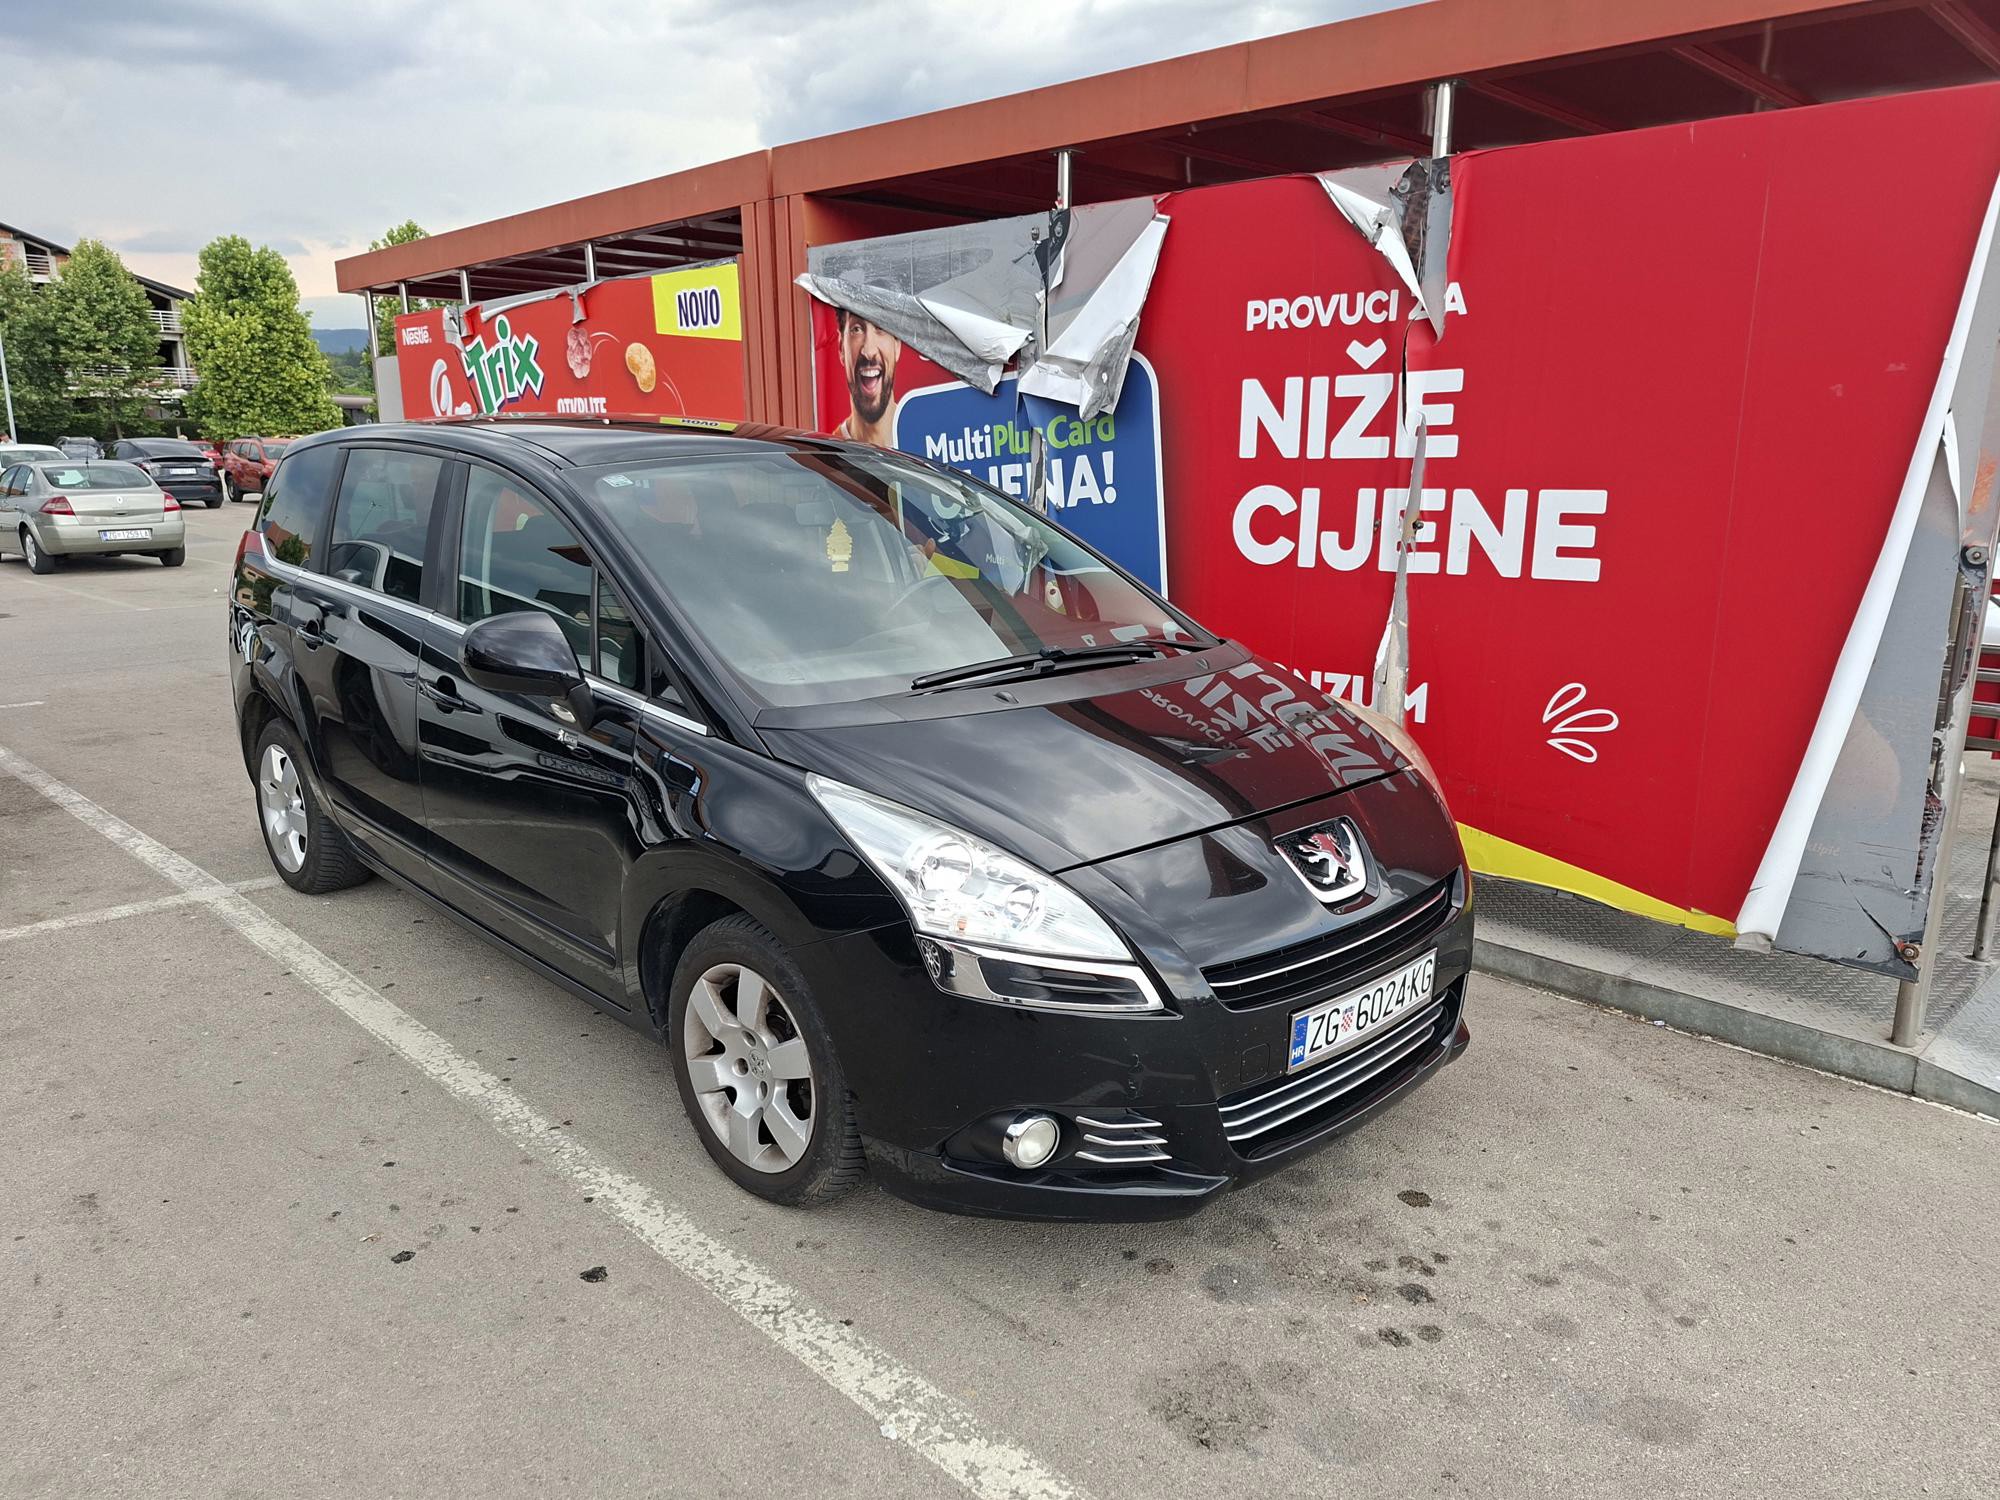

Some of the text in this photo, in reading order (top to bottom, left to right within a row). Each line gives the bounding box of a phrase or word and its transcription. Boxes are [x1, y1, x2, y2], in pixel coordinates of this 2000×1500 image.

[676, 287, 721, 329] NOVO
[1246, 289, 1399, 331] PROVUCI
[461, 314, 544, 416] Trix
[1238, 338, 1465, 460] NIŽE
[925, 414, 1116, 464] MultiPluCard
[1232, 485, 1608, 582] CIJENE
[1292, 1045, 1304, 1059] HR
[1309, 1008, 1340, 1053] ZG
